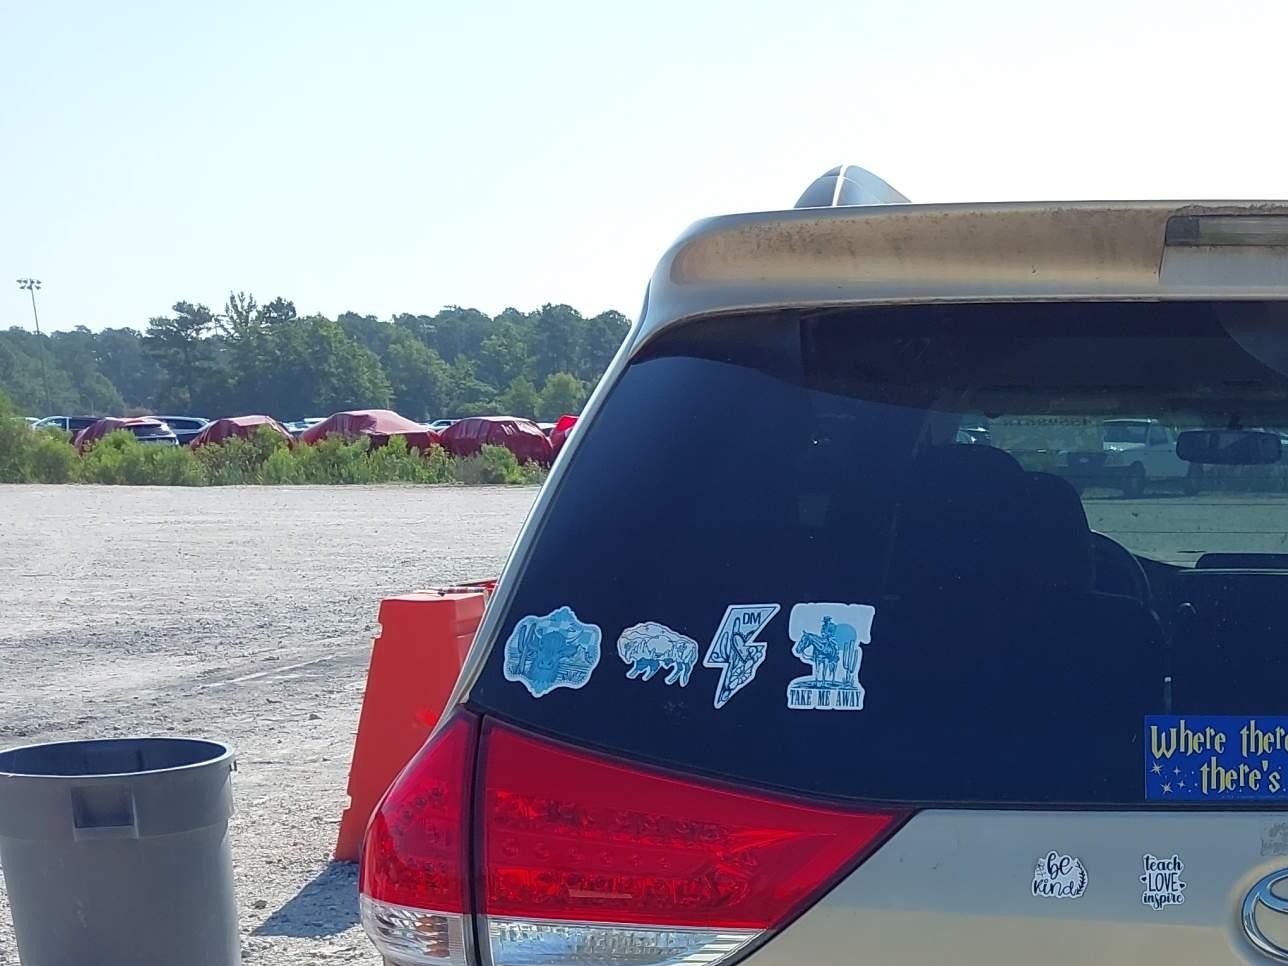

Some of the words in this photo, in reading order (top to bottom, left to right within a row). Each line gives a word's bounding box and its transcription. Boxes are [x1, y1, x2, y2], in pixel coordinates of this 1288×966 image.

[743, 612, 762, 625] DM
[790, 689, 812, 706] TAKE
[818, 690, 831, 706] ME
[836, 690, 861, 707] AWAY
[1151, 719, 1227, 759] Where
[1200, 757, 1281, 795] there's
[1046, 852, 1073, 879] be
[1145, 855, 1182, 871] teach
[1148, 873, 1179, 892] LOVE
[1143, 892, 1183, 909] inspire
